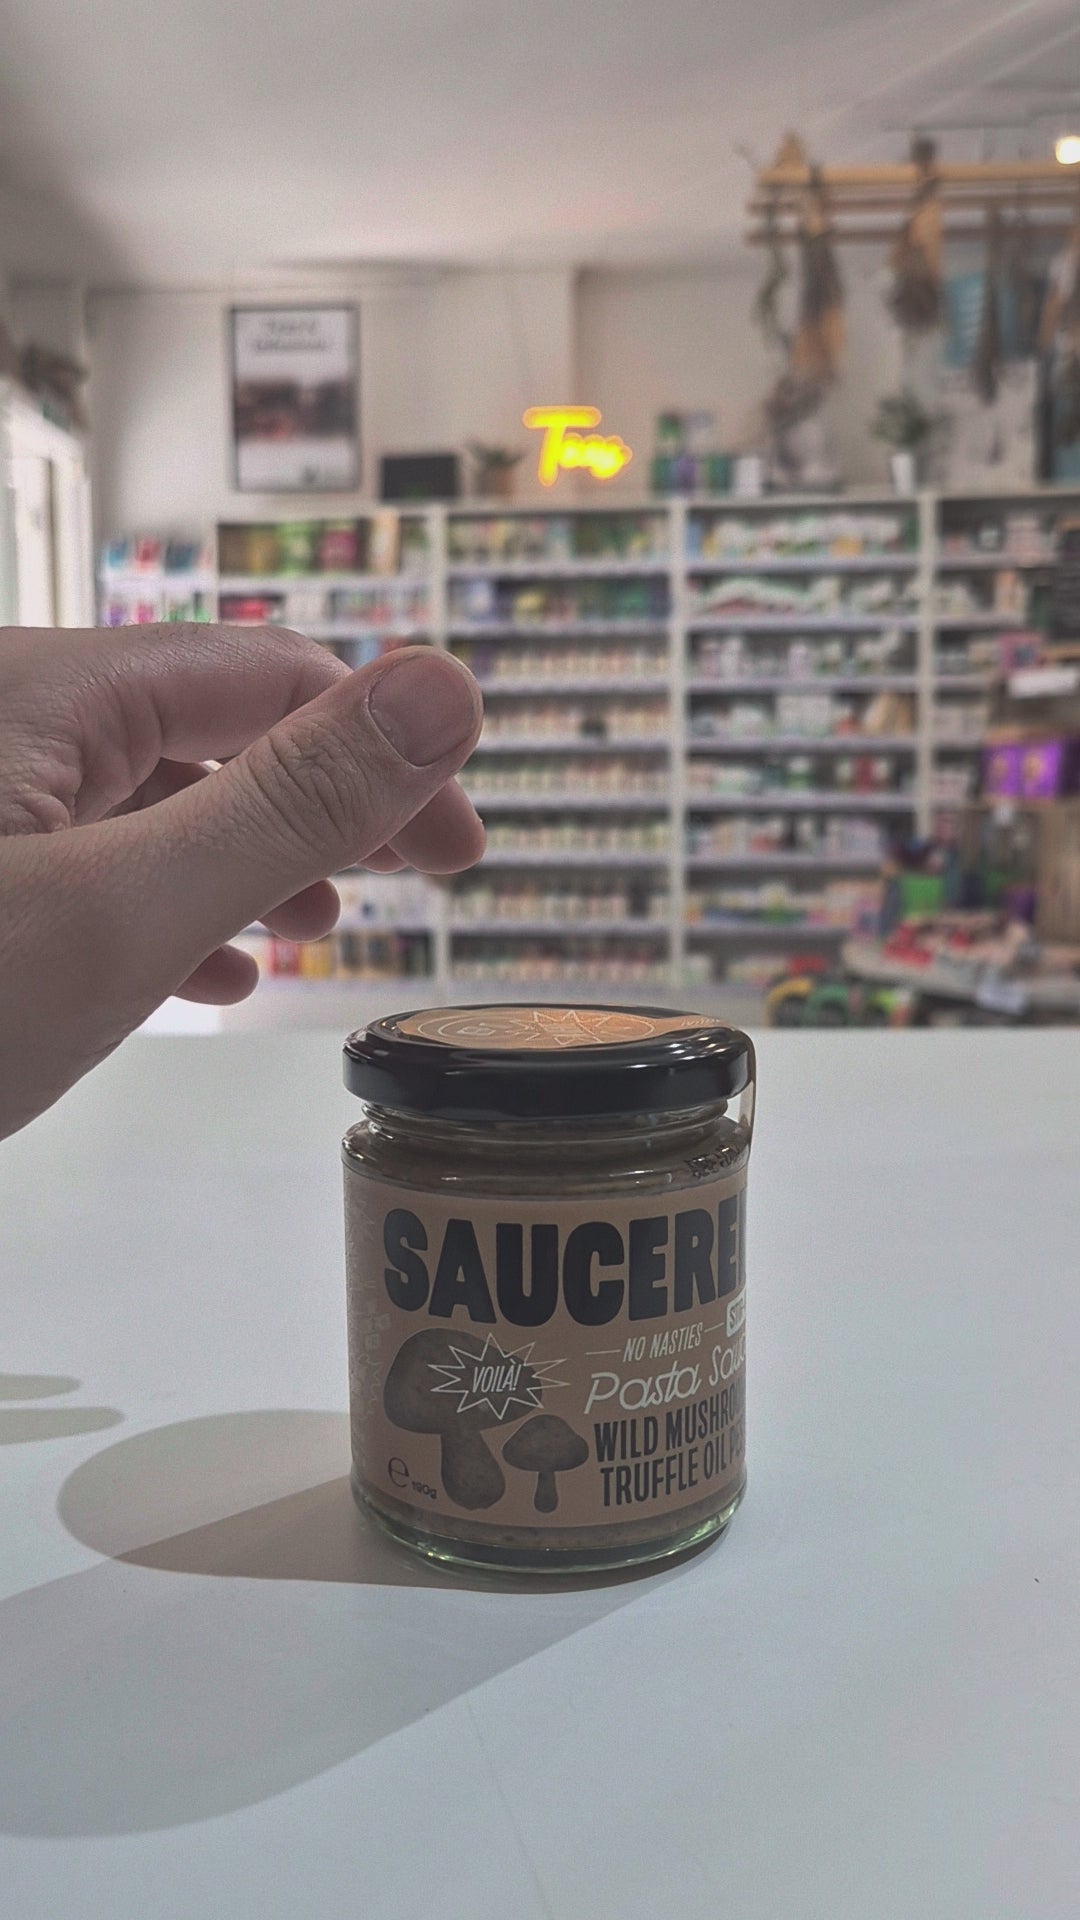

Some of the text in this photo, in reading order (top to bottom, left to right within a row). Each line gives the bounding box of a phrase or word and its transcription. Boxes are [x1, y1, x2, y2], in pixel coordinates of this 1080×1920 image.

[623, 1322, 703, 1363] NO NASTIES
[472, 1358, 521, 1393] VOILÀ!
[584, 1361, 702, 1414] Pasta
[594, 1415, 659, 1463] WILD
[666, 1382, 744, 1451] MUSHRO
[600, 1447, 698, 1507] TRUFFLE
[703, 1432, 728, 1480] OIL
